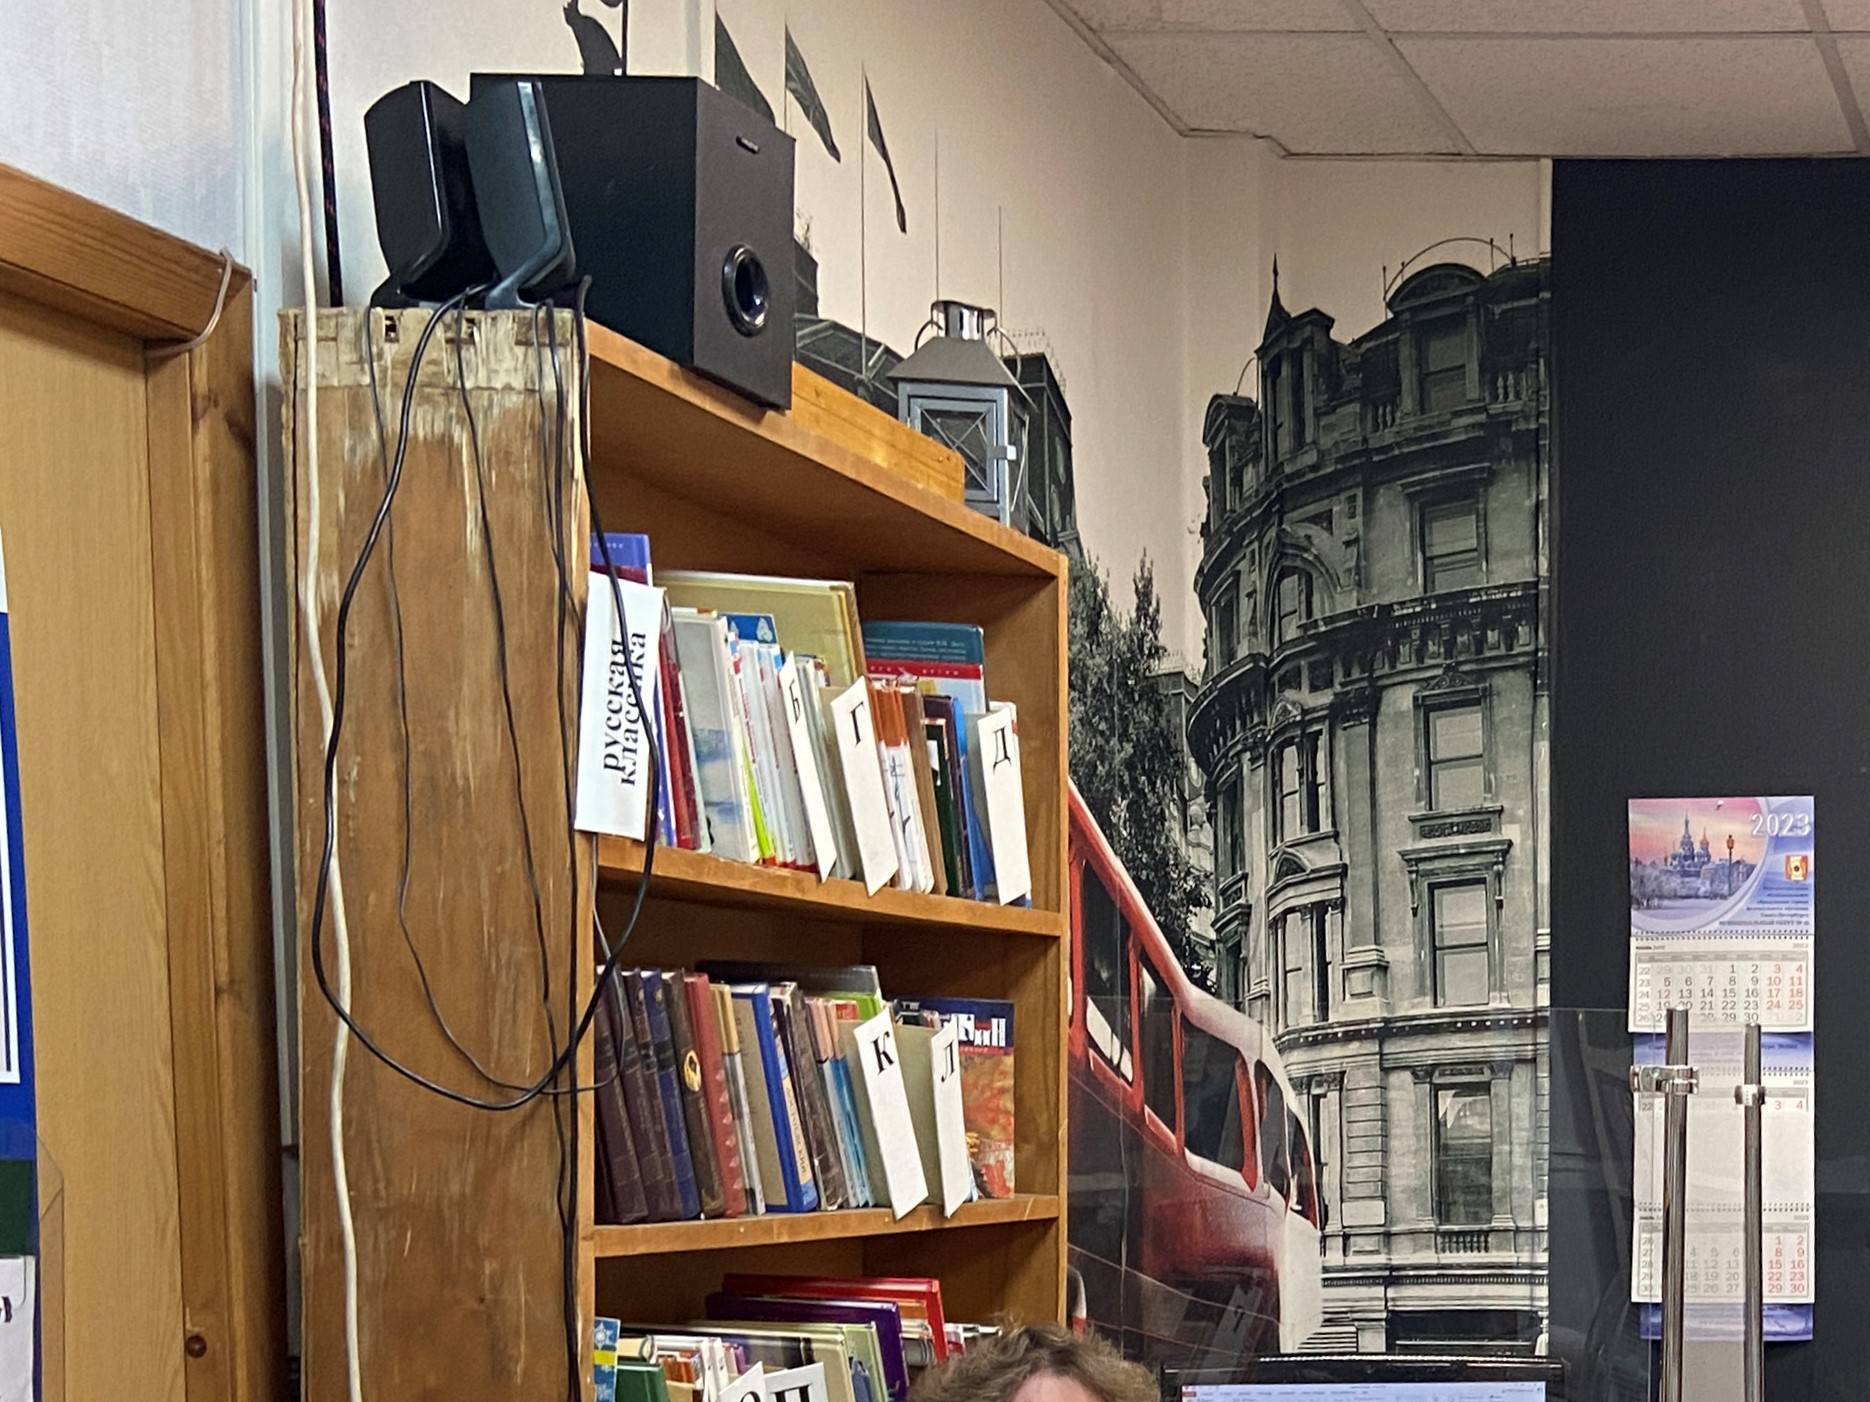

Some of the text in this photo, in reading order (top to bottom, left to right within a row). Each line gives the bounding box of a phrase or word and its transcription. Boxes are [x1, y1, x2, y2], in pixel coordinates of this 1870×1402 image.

[603, 639, 627, 772] русская
[786, 681, 802, 725] Б
[620, 632, 647, 786] класска
[848, 703, 866, 746] Г
[992, 738, 1012, 775] Д
[1751, 813, 1811, 836] 2023
[1751, 964, 1758, 973] 2
[1774, 964, 1781, 974] 3
[1664, 977, 1671, 987] 5
[1685, 977, 1692, 986] 6
[1707, 977, 1714, 986] 7
[1729, 977, 1736, 986] 8
[1751, 976, 1758, 986] 9
[1767, 977, 1781, 986] 10
[1789, 976, 1802, 986] 11
[1657, 990, 1671, 999] 12
[1679, 989, 1692, 999] 13
[1701, 989, 1714, 999] 14
[1723, 989, 1736, 998] 15
[1745, 989, 1758, 998] 16
[1767, 989, 1781, 998] 17
[1789, 989, 1803, 998] 18
[1700, 1001, 1713, 1009] 21
[1722, 1001, 1736, 1010] 22
[1744, 1001, 1758, 1010] 23
[1766, 1001, 1781, 1009] 24
[1789, 1001, 1803, 1009] 25
[1722, 1013, 1736, 1022] 29
[1745, 1013, 1758, 1022] 30
[871, 1031, 896, 1074] К
[939, 1043, 956, 1082] Л
[1775, 1101, 1782, 1110] 3
[1797, 1236, 1804, 1245] 2
[1797, 1248, 1804, 1257] 9
[1769, 1260, 1782, 1269] 15
[1790, 1260, 1804, 1269] 16
[1704, 1272, 1718, 1281] 19
[1726, 1272, 1739, 1281] 20
[1768, 1272, 1782, 1281] 22
[1790, 1272, 1804, 1281] 23
[1704, 1284, 1718, 1293] 26
[1726, 1284, 1739, 1293] 27
[1769, 1284, 1782, 1293] 29
[1790, 1284, 1804, 1293] 30
